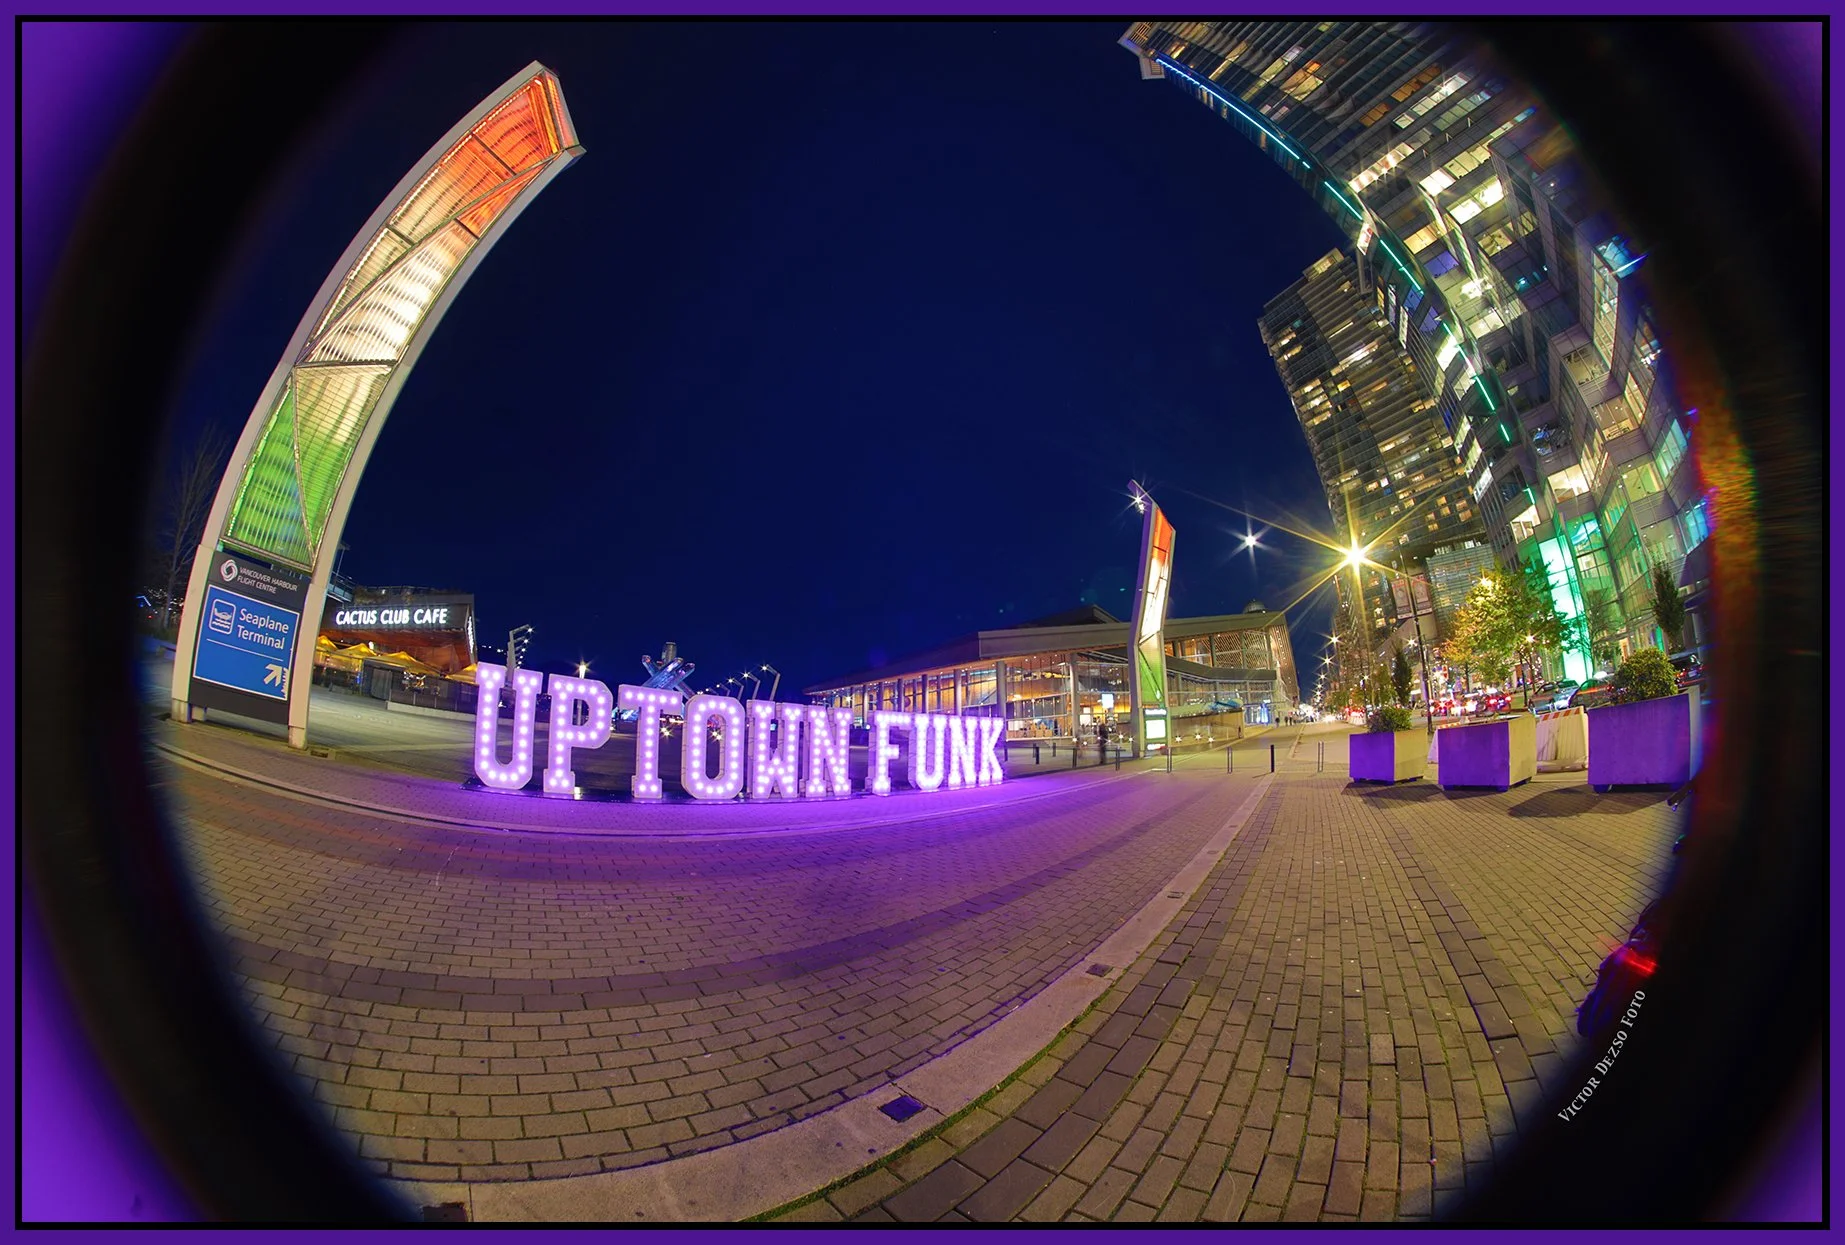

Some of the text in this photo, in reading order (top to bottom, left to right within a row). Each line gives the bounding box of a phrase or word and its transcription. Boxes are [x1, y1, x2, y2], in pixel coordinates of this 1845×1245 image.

[237, 575, 277, 594] FLIGHT CENTRE
[239, 567, 298, 592] VANCOUVER HARBOUR
[239, 608, 289, 634] Seaplane
[335, 608, 448, 625] CACTUS CLUB CAFE
[237, 624, 286, 650] Terminal
[474, 661, 1005, 801] UPTOWN FUNK
